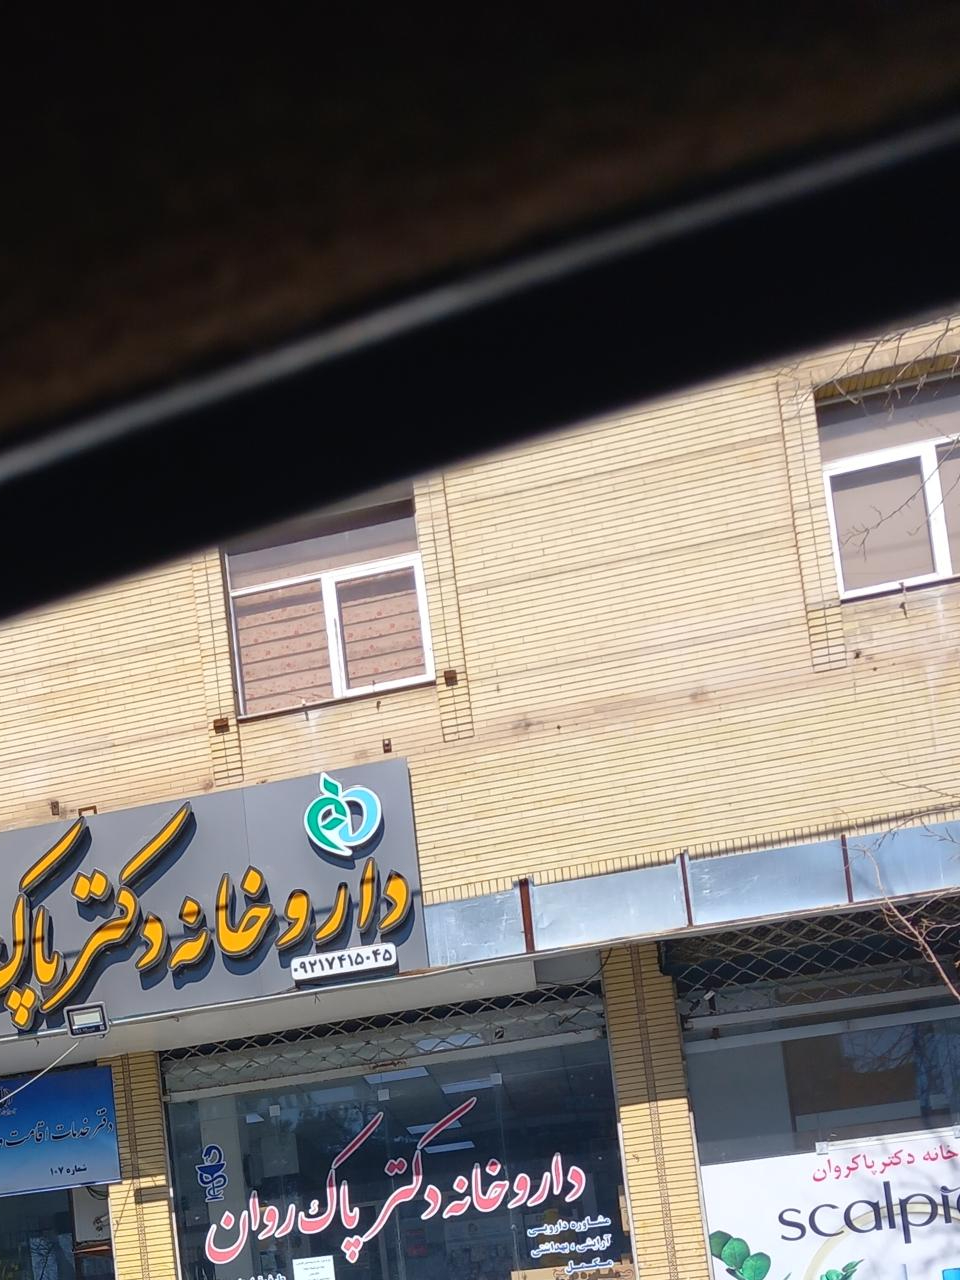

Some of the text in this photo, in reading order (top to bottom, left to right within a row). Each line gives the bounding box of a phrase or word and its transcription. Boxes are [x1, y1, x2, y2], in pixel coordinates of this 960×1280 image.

[40, 800, 195, 1013] دکتر
[168, 856, 413, 972] داروخانه
[5, 1120, 50, 1148] اقامت
[51, 1117, 91, 1140] خدمات
[93, 1107, 114, 1137] دفتر
[50, 1163, 88, 1177] شماره ۱۰۷
[362, 1097, 478, 1243] دکتر
[811, 1154, 877, 1183] پاکروان
[880, 1149, 916, 1175] دکتر
[443, 1152, 587, 1221] داروخانه
[527, 1214, 612, 1237] مشاوره دارویی
[530, 1241, 570, 1258] بهداشتی
[564, 1257, 614, 1275] مکمل
